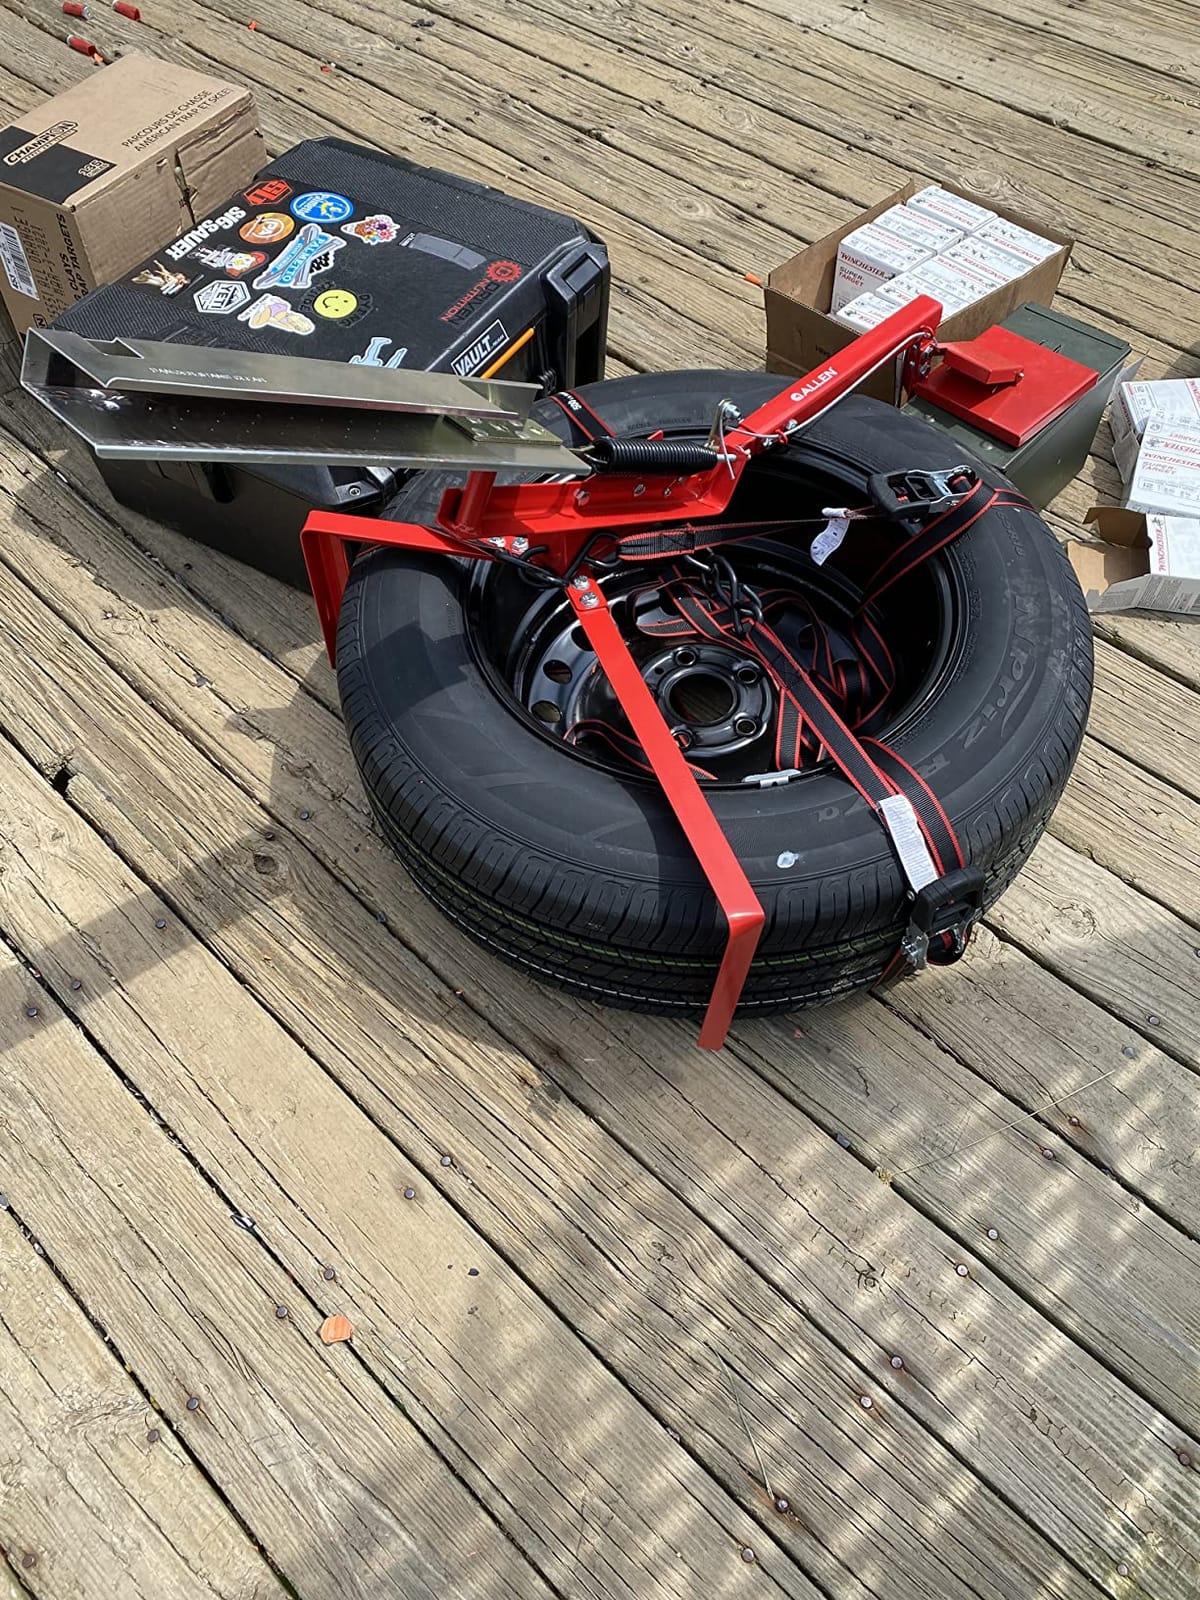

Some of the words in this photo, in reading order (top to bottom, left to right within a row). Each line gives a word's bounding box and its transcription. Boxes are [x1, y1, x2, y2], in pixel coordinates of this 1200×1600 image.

[134, 123, 180, 151] AMERICAN
[176, 108, 199, 123] TRAP
[199, 100, 211, 110] ET
[165, 110, 180, 120] DE
[178, 89, 213, 112] CHASSE
[7, 121, 74, 163] CHAMPION
[215, 206, 247, 230] SIG
[56, 213, 81, 272] TARGETS
[165, 219, 219, 261] SAUER
[60, 253, 79, 291] CLAYS
[839, 271, 864, 287] TARGET
[840, 251, 886, 279] WINCHESTER
[210, 284, 233, 310] YETI
[440, 278, 491, 321] NUTRITION
[448, 282, 500, 326] DRIVEN
[455, 334, 491, 377] VAULT
[800, 366, 838, 396] ALLEN
[1155, 528, 1167, 572] WINCHESTER
